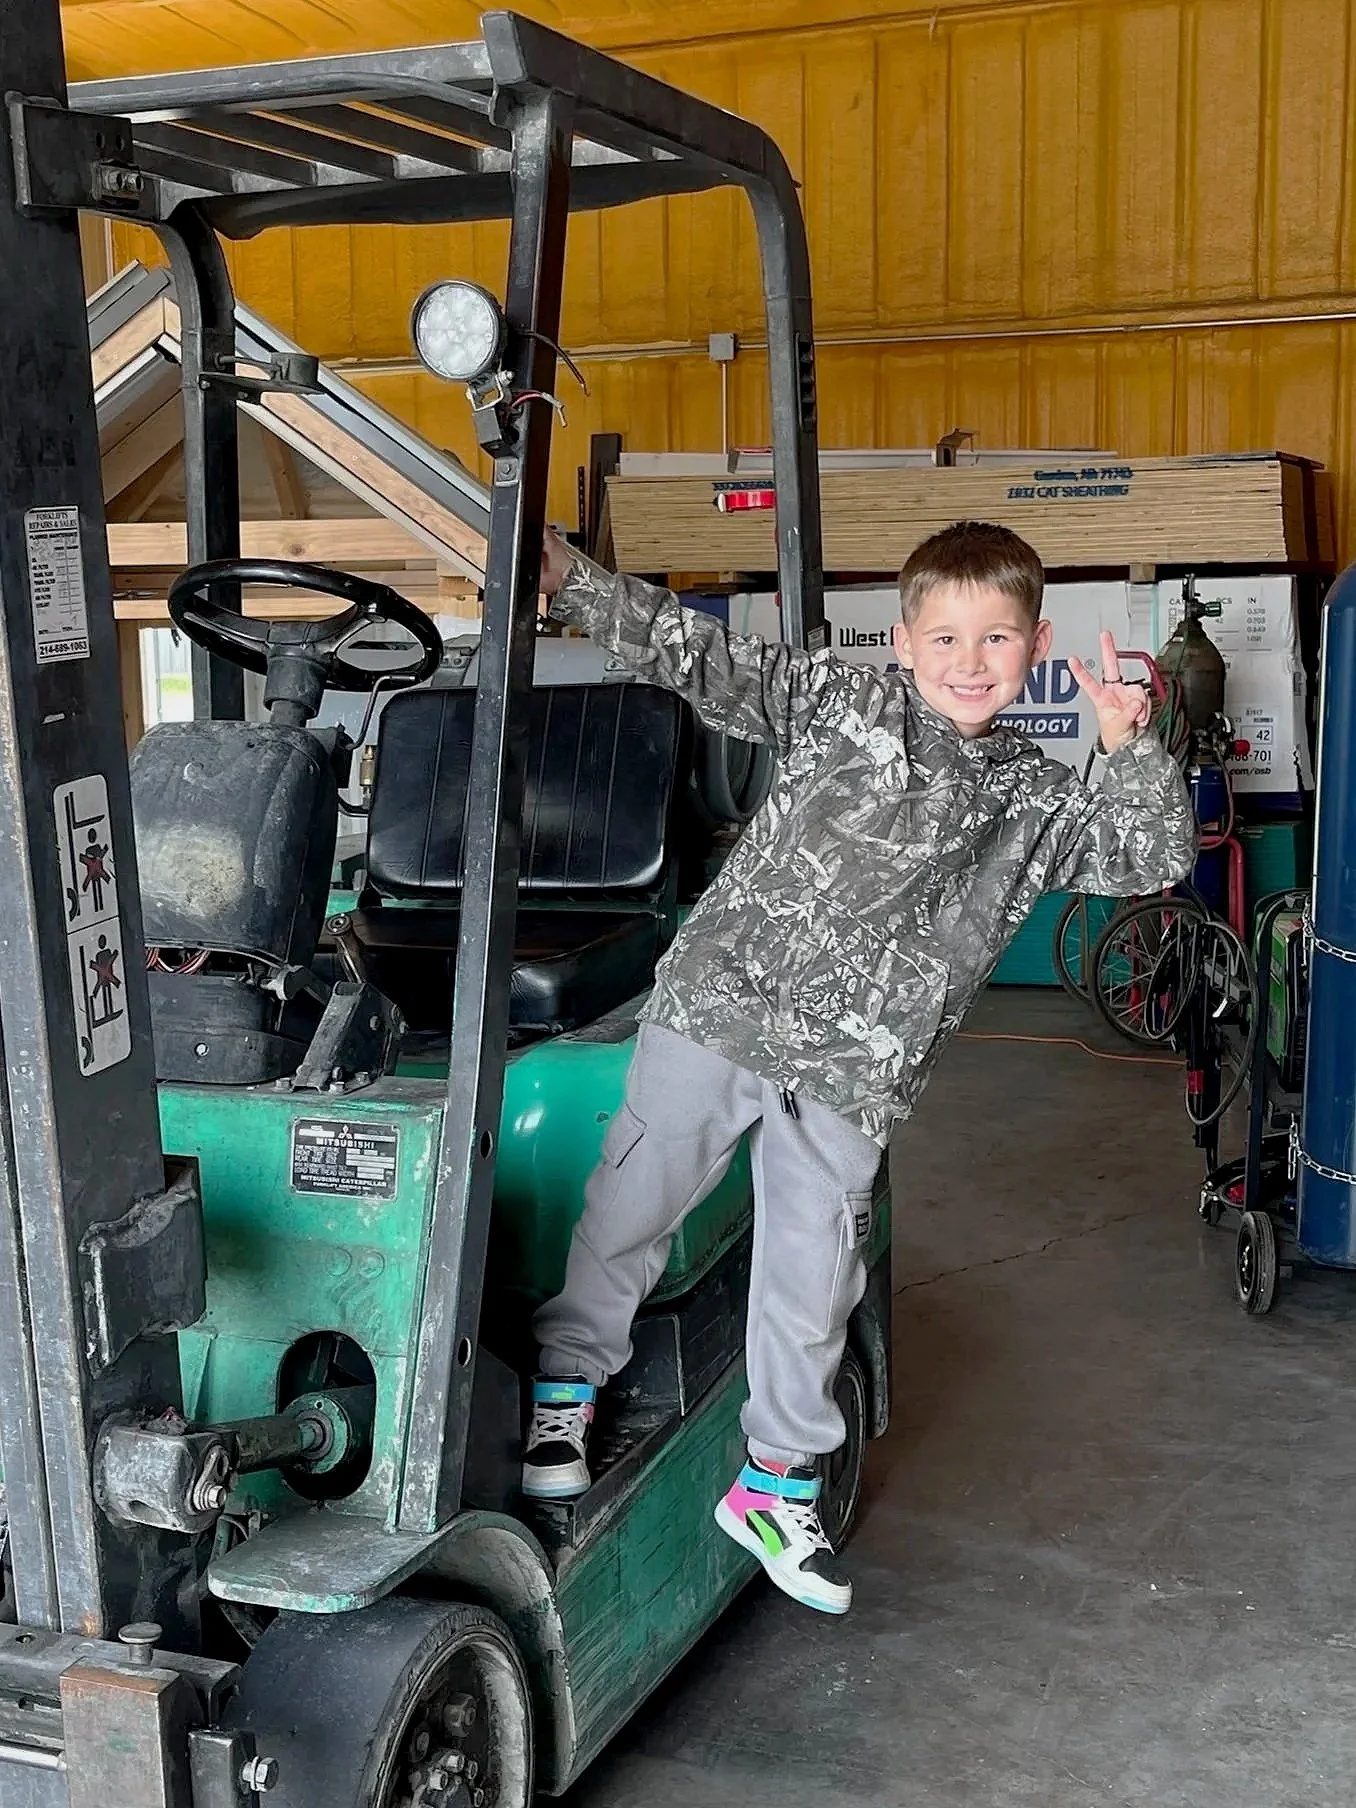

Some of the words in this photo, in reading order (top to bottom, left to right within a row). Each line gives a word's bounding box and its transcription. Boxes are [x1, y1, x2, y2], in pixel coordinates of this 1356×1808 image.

[1169, 598, 1184, 606] CA
[840, 628, 886, 647] West
[1013, 660, 1080, 704] ND
[1256, 730, 1270, 741] 42
[316, 1138, 374, 1149] MITSUBISHI
[301, 1175, 340, 1183] MITSUBISHI
[341, 1178, 387, 1187] CATERPILLAR
